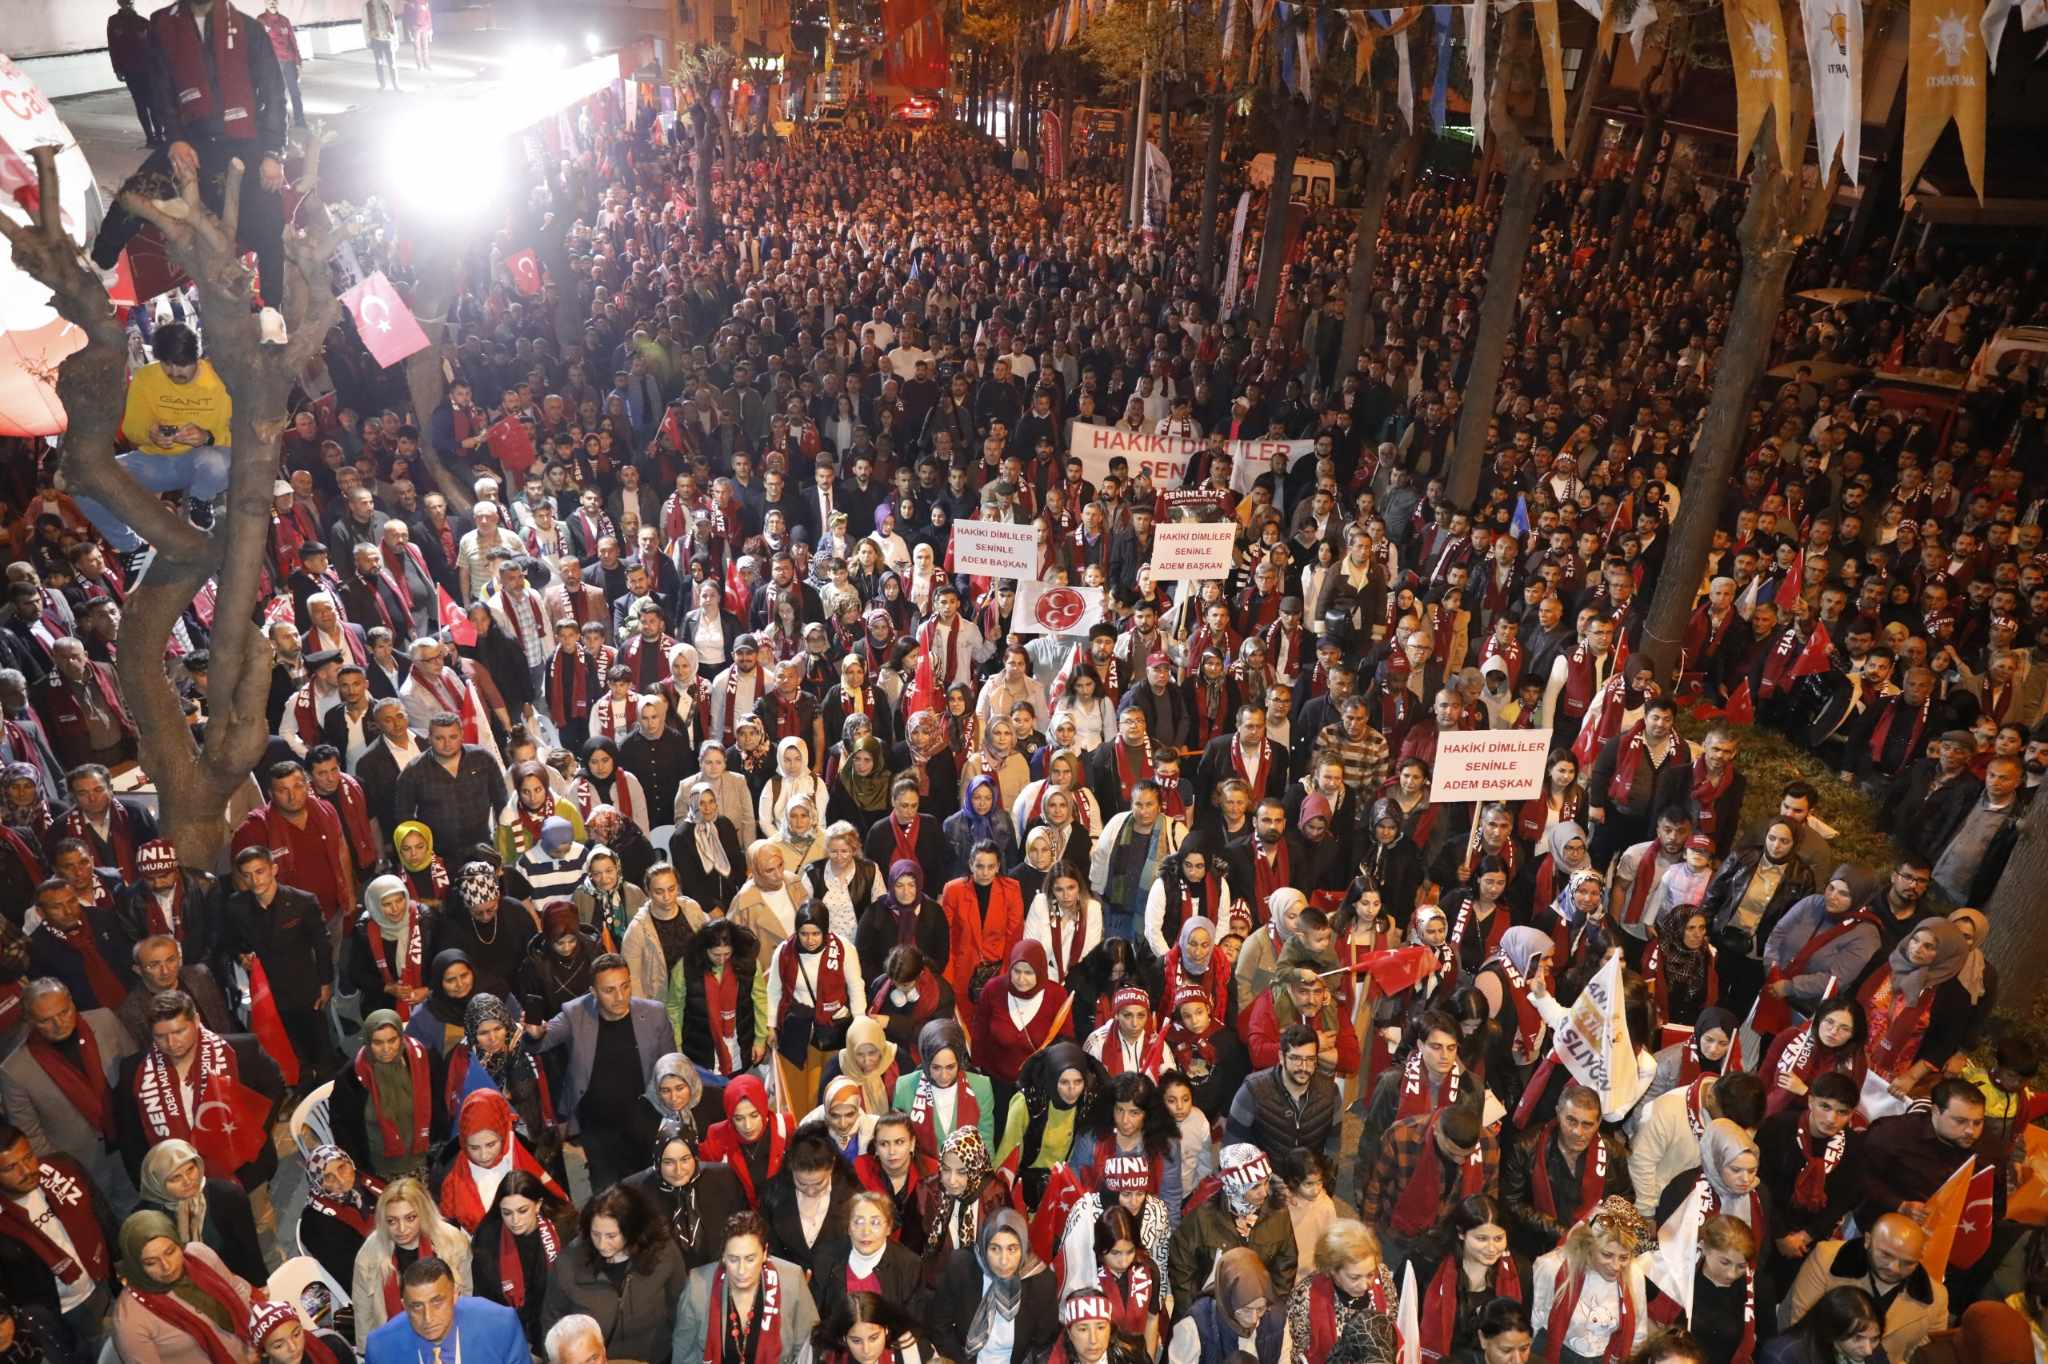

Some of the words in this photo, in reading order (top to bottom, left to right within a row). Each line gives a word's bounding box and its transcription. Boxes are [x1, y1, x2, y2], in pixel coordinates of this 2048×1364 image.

[159, 395, 213, 406] GANT
[961, 555, 987, 565] ADEM
[989, 558, 1027, 568] BAŞKAN
[1159, 562, 1184, 570] ADEM
[1186, 562, 1222, 571] BAŞKAN
[1444, 742, 1486, 753] HAKİKİ
[1488, 740, 1546, 752] DİMLİLER
[1465, 760, 1518, 772] SENİNLE
[1444, 780, 1479, 790] ADEM
[1482, 779, 1534, 790] BAŞKAN
